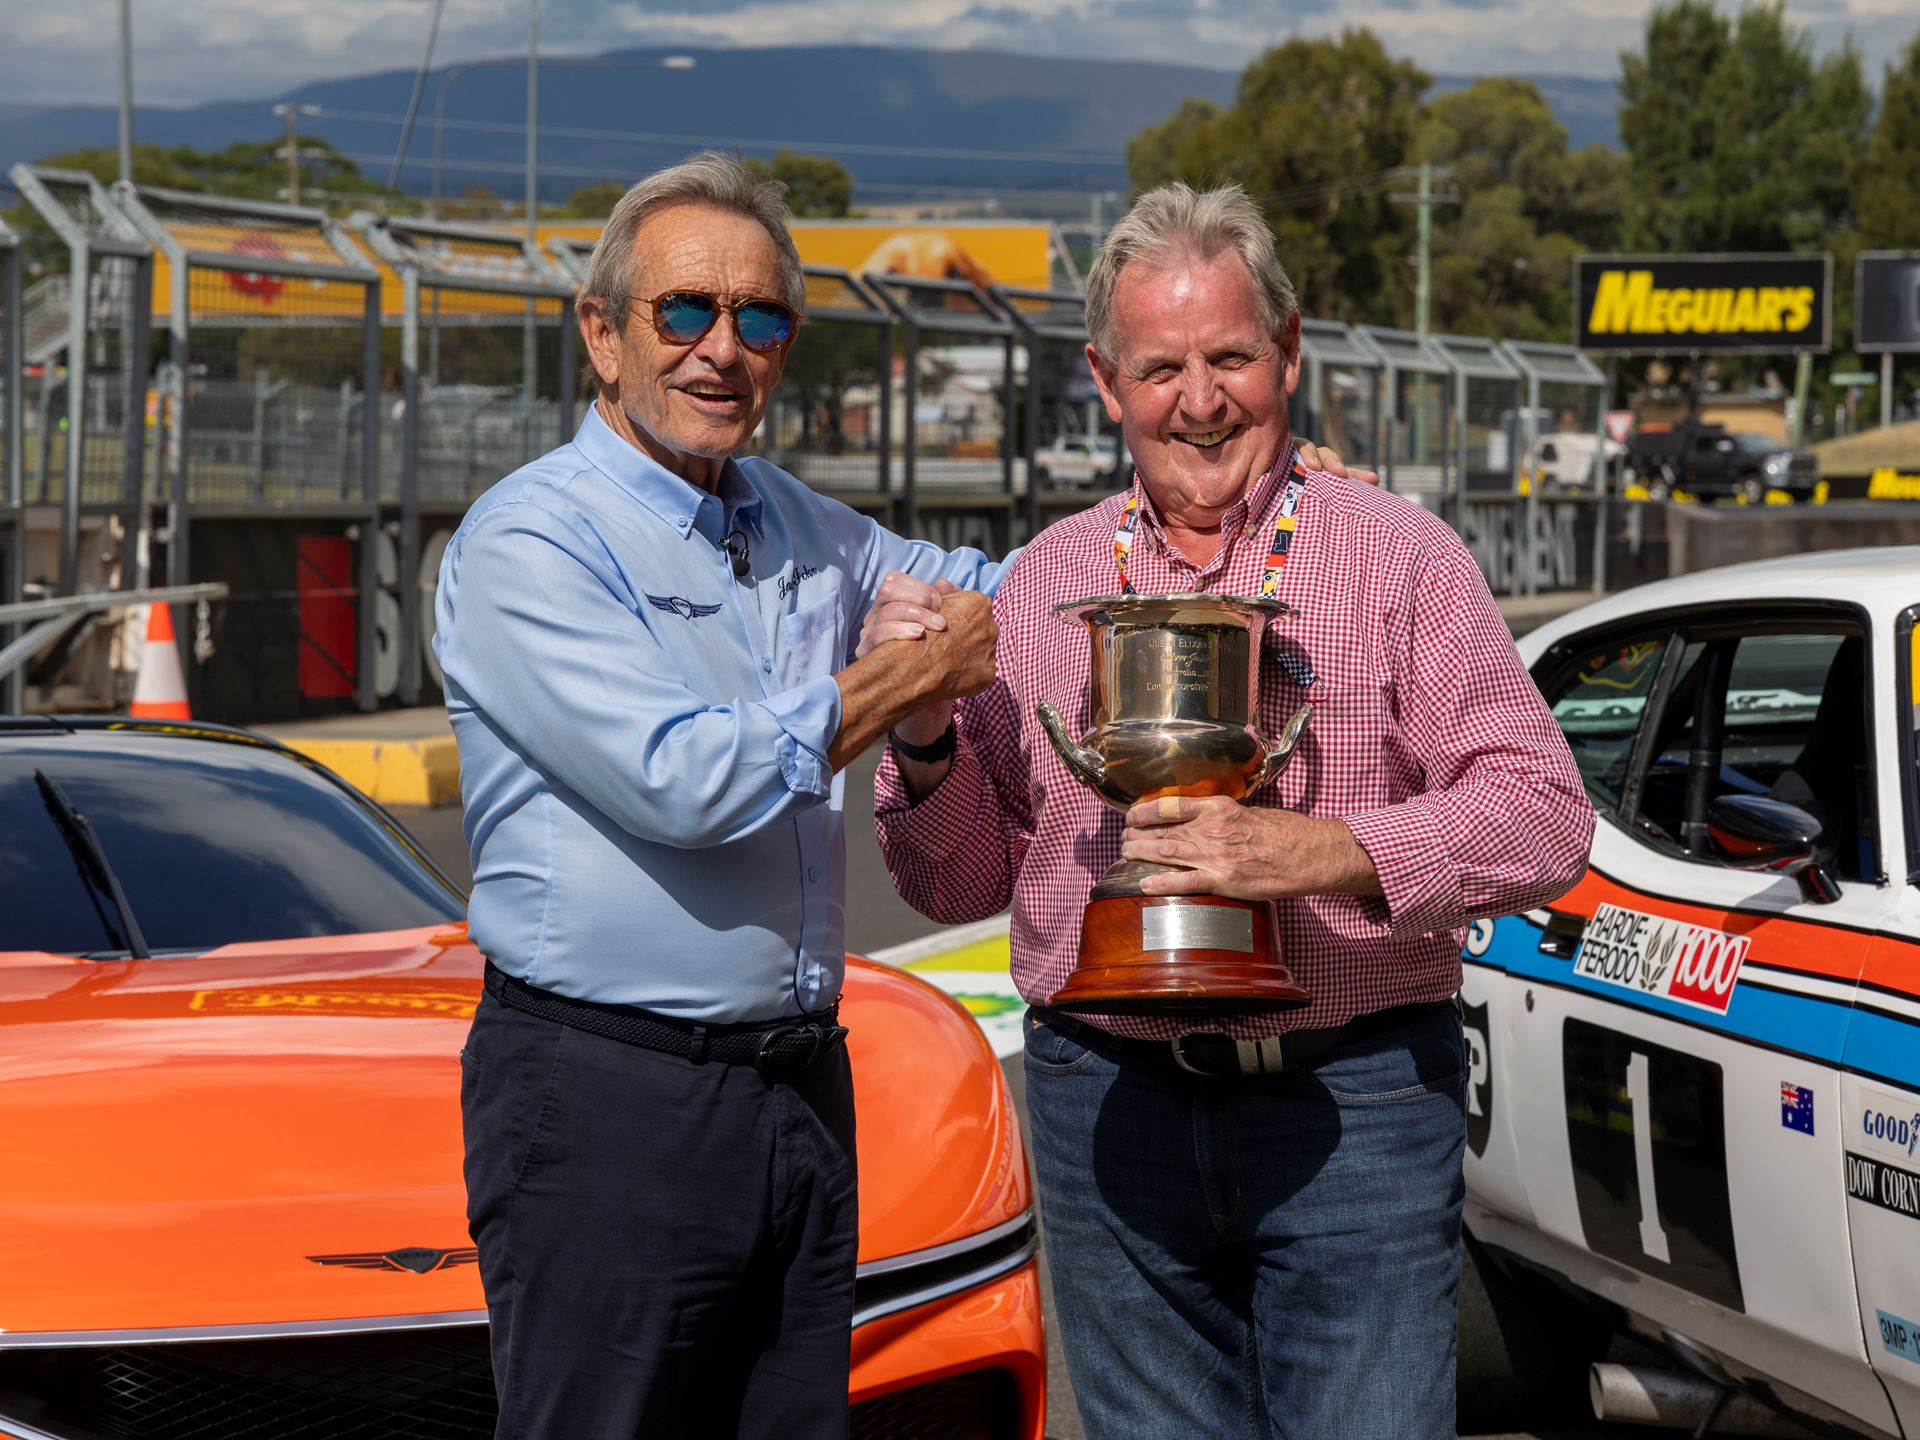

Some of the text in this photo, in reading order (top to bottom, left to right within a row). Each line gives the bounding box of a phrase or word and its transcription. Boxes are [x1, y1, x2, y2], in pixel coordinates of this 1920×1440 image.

[1588, 270, 1814, 334] MEGUIAR'S
[1577, 938, 1640, 985] FERODO
[1676, 926, 1743, 996] 1000
[1626, 1051, 1671, 1264] 1
[1847, 1155, 1920, 1216] DOW CORN
